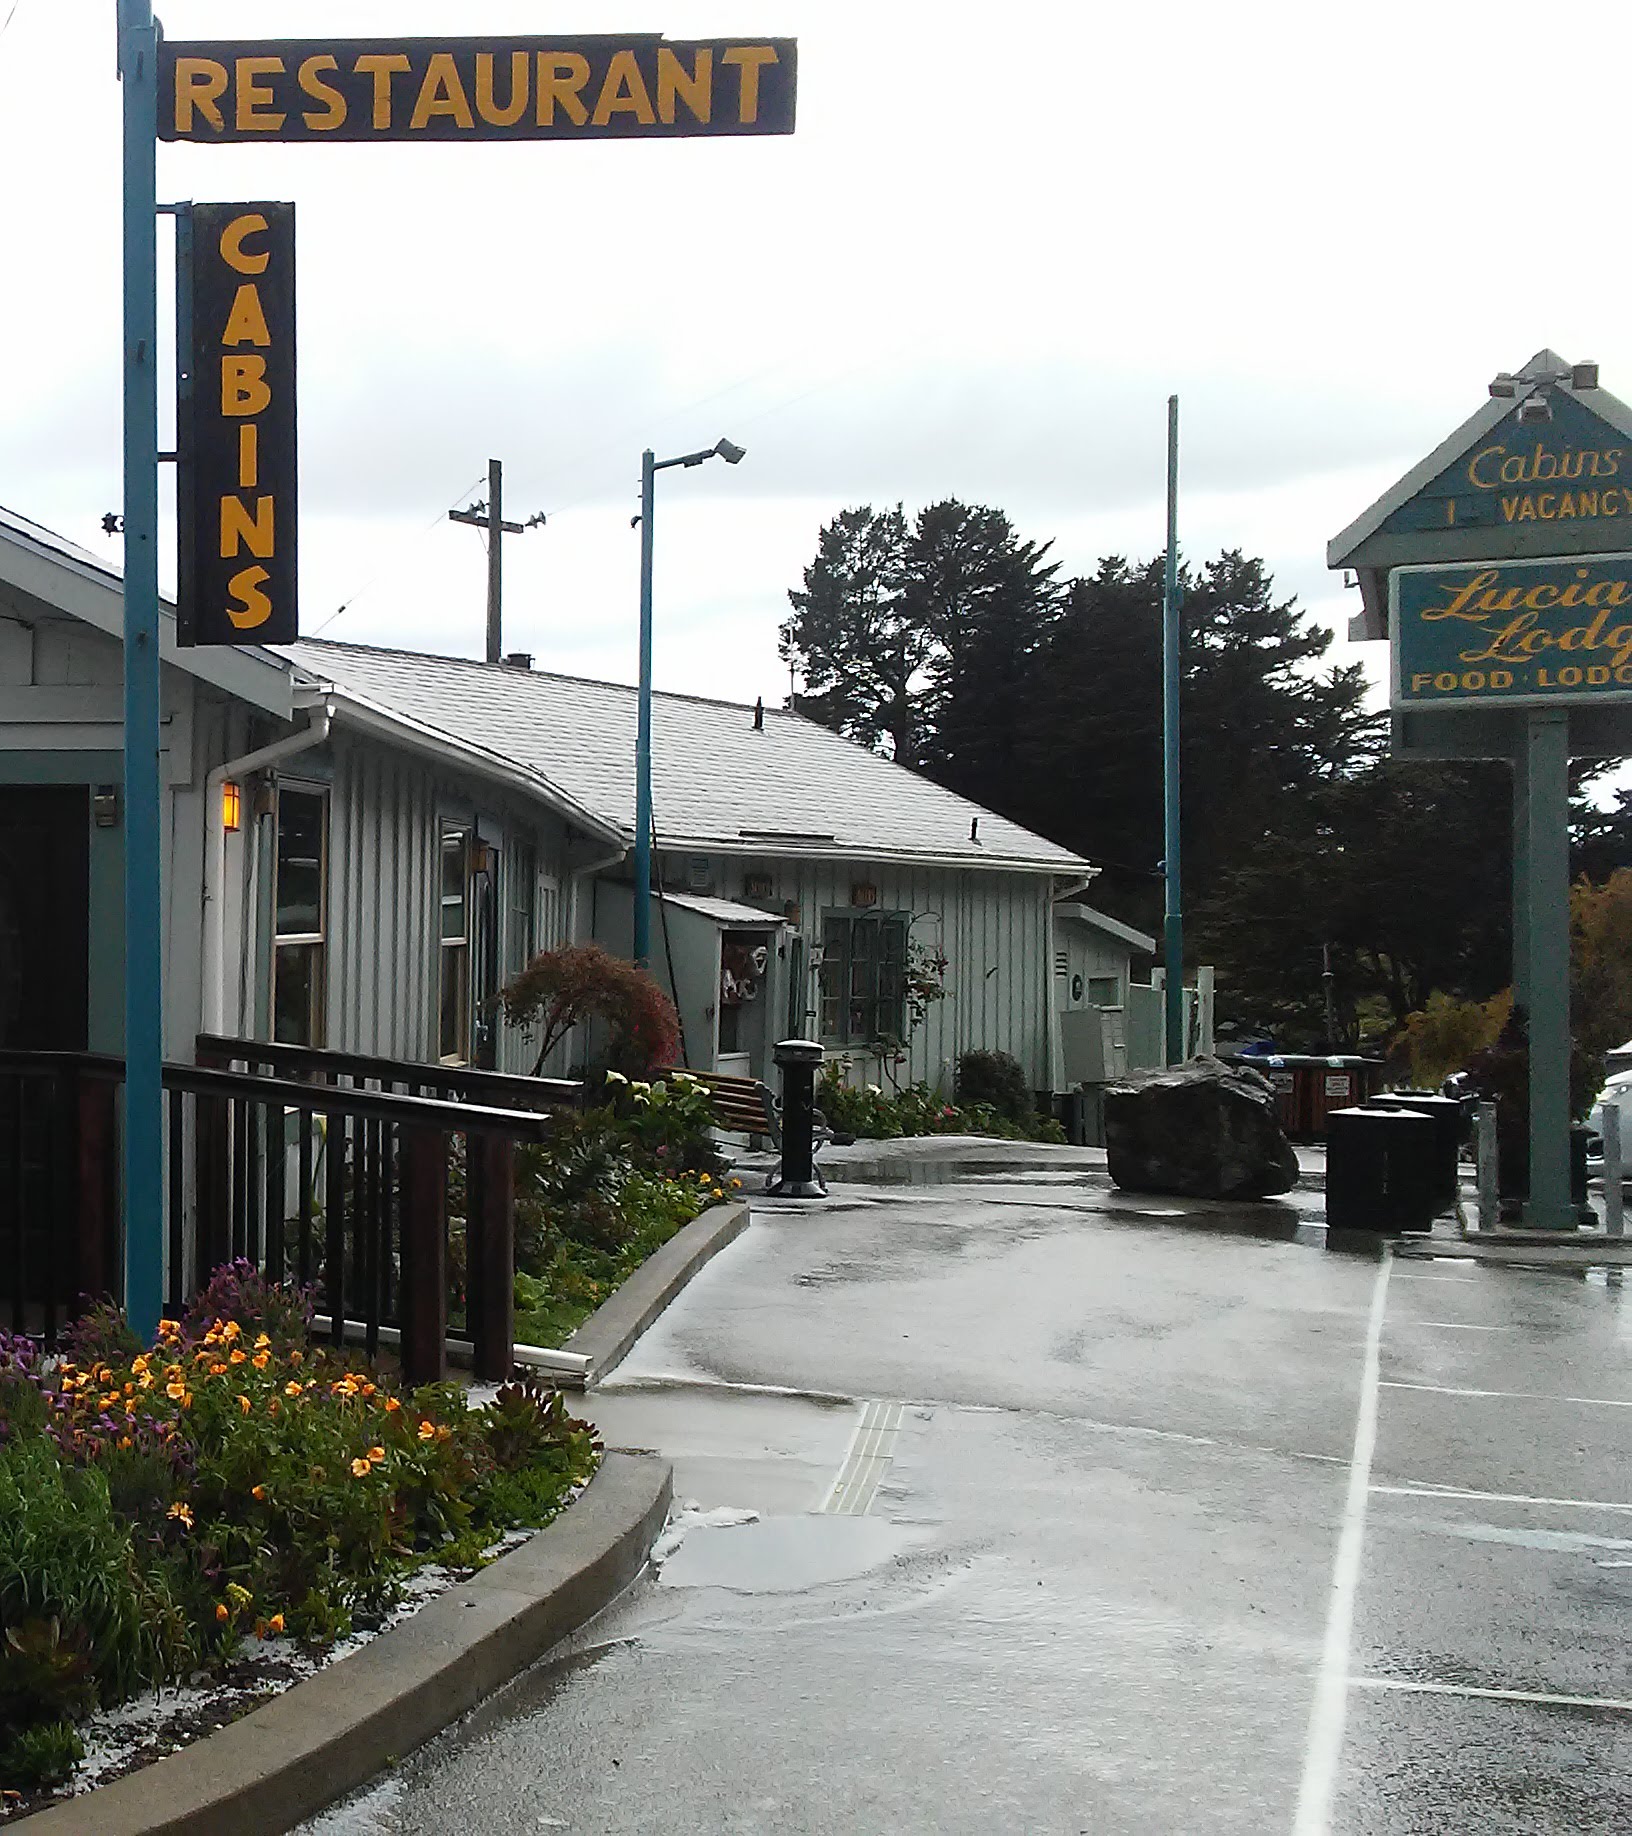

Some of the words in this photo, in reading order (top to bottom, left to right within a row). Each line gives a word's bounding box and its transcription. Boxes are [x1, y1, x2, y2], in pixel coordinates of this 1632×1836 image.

[175, 46, 779, 133] RESTAURANT
[219, 213, 275, 629] CABINS
[1469, 443, 1622, 488] Cabins
[1421, 569, 1632, 621] Lucia
[1411, 670, 1514, 692] FOOD
